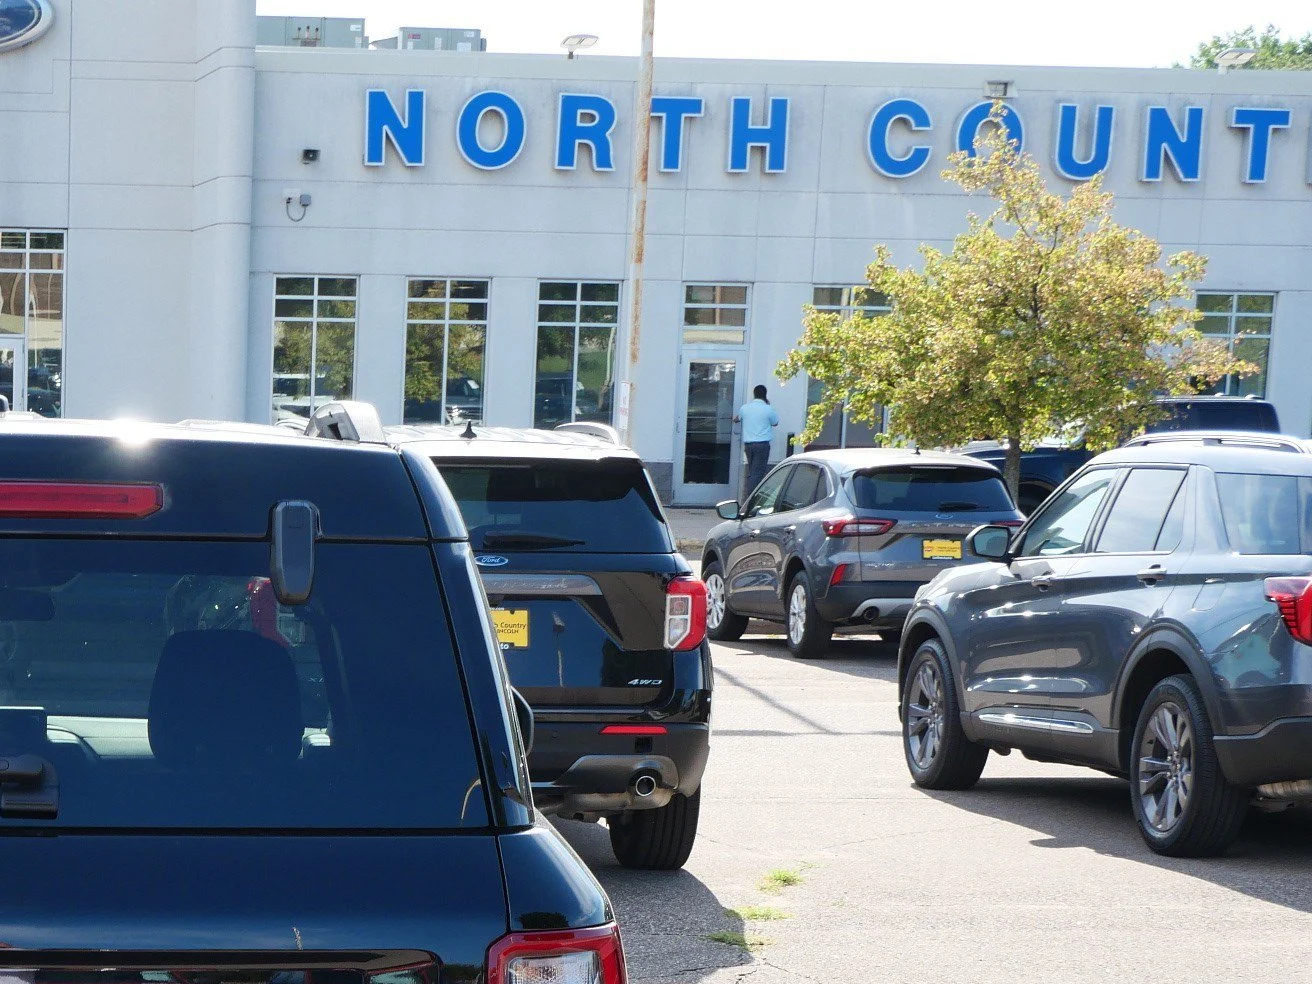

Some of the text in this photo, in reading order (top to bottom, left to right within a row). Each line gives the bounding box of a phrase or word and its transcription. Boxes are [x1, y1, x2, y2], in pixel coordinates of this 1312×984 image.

[363, 89, 1312, 184] NORTH COUNT
[500, 621, 527, 630] Country
[627, 678, 663, 686] 4WD
